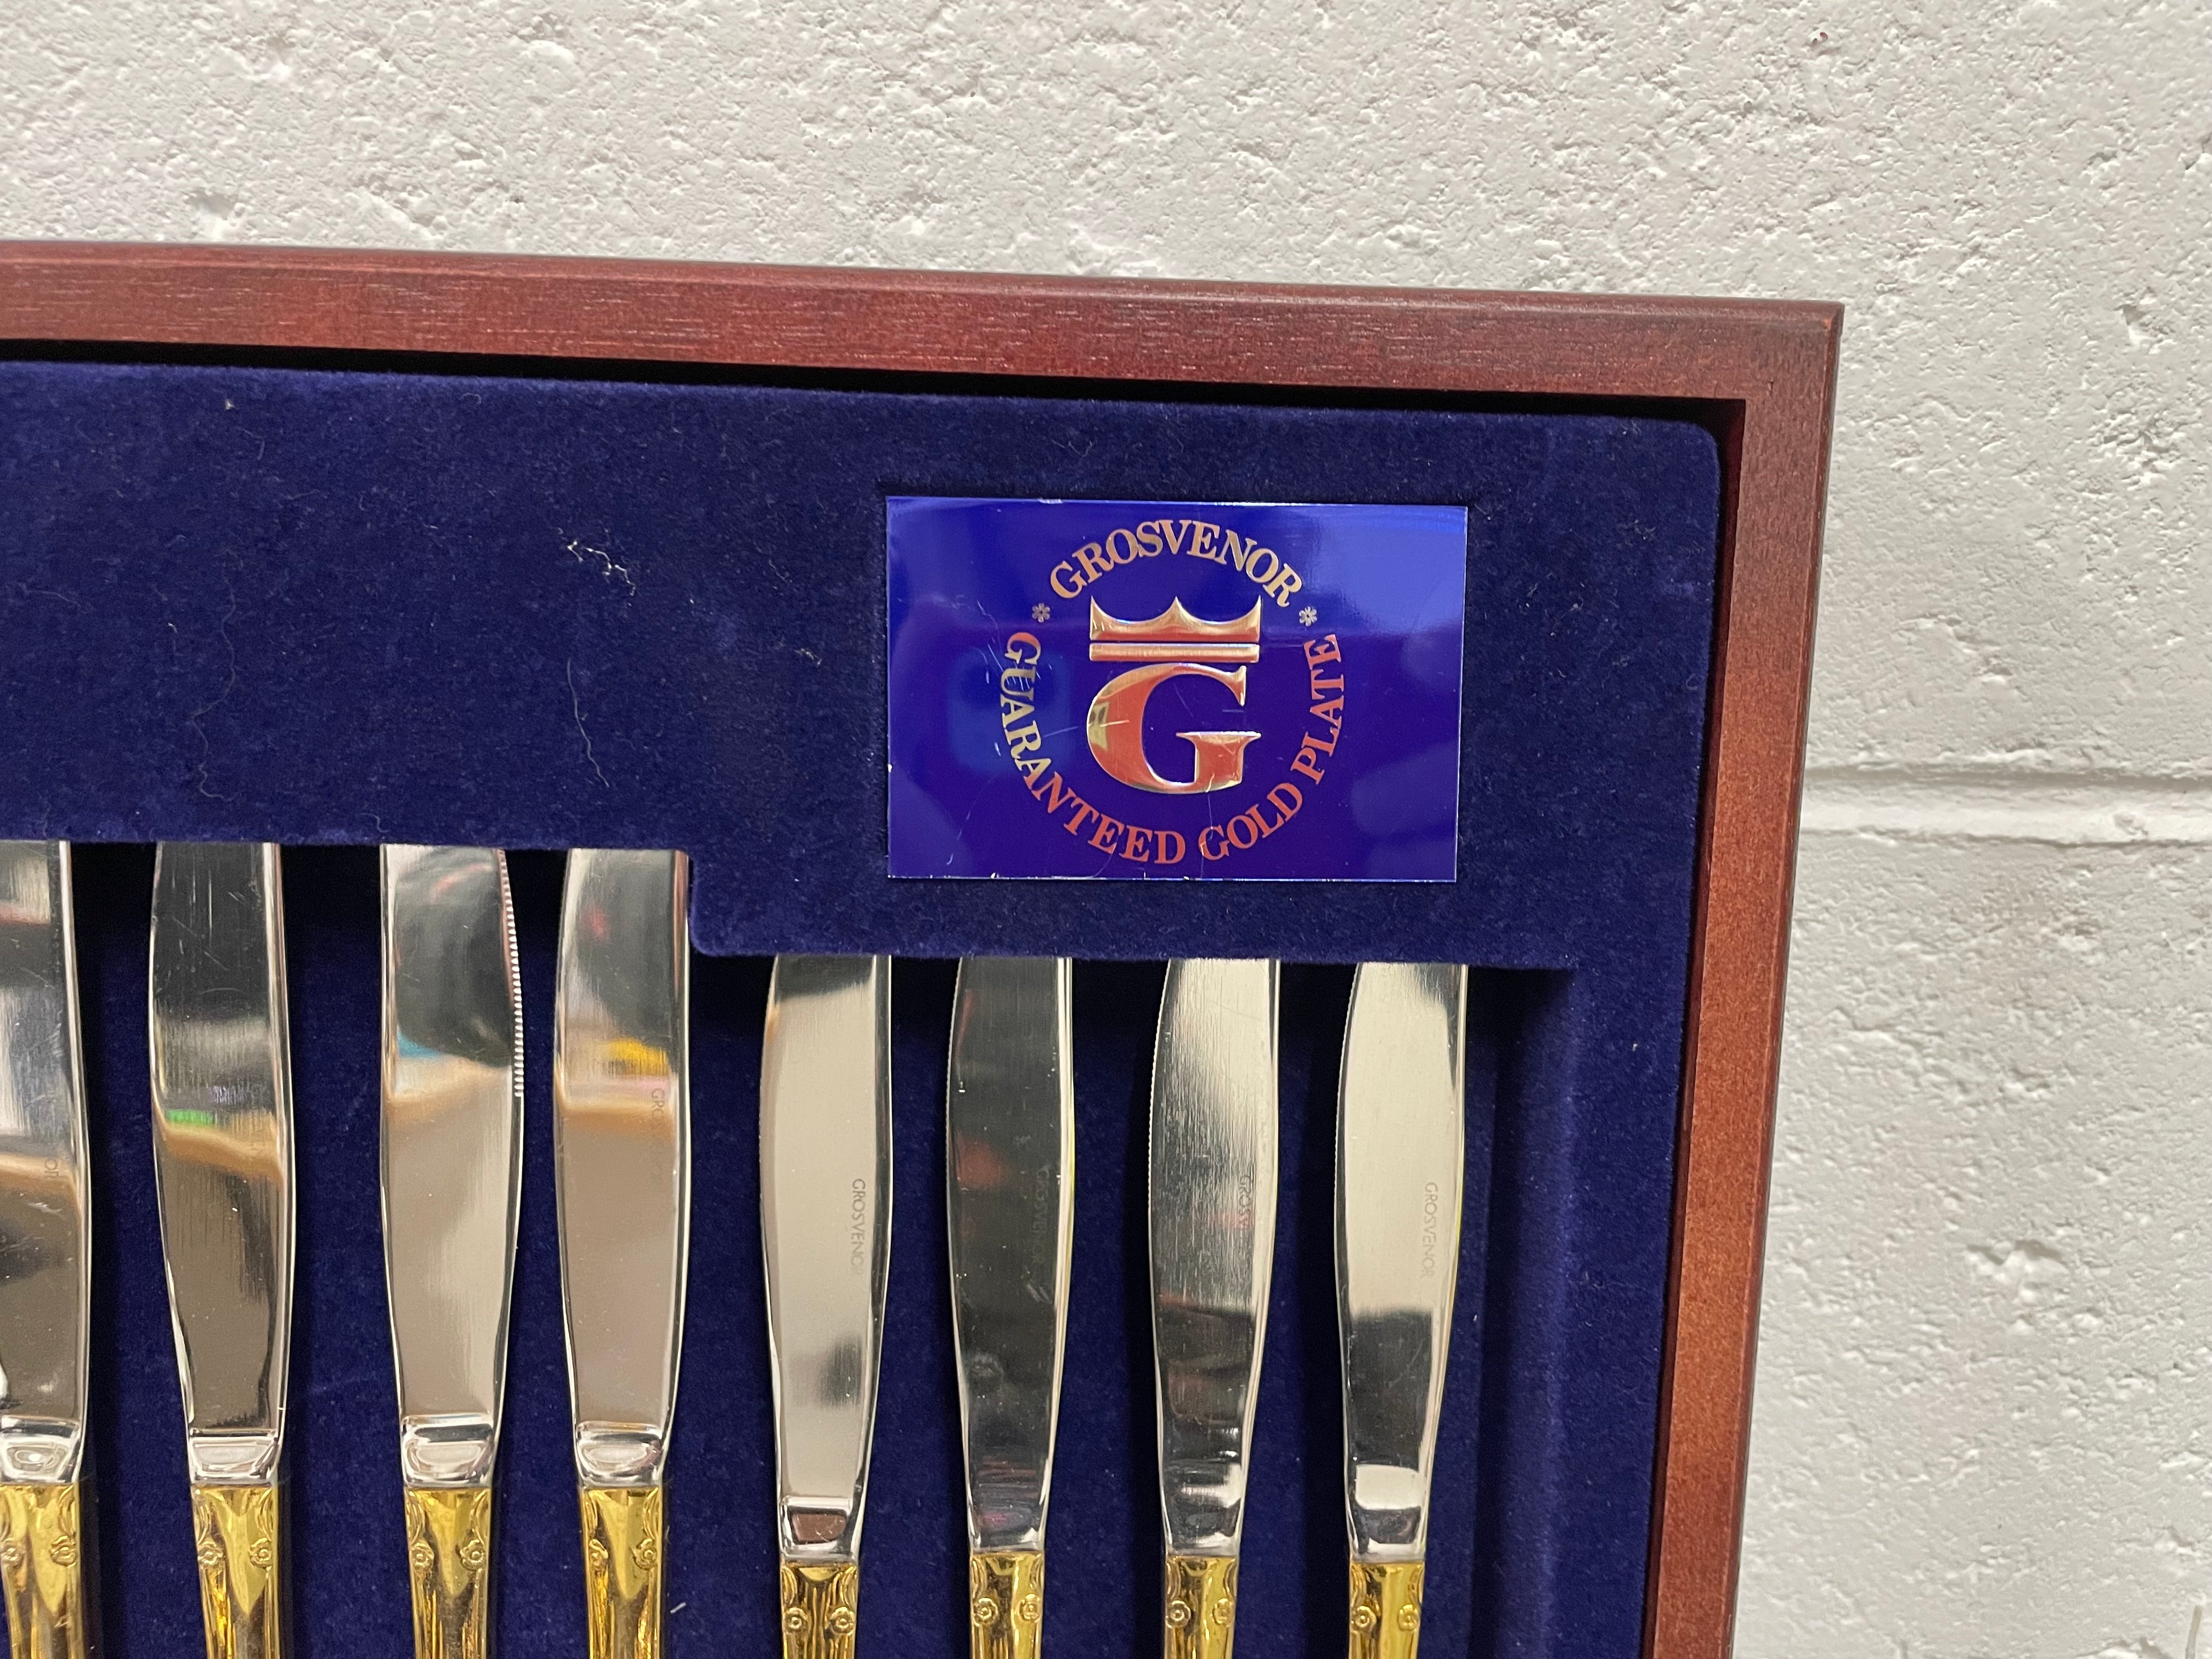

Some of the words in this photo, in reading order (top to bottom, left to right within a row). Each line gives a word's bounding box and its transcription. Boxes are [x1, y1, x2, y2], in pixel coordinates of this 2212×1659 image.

[1049, 519, 1303, 608] GROSVENOR
[1000, 631, 1186, 865] GUARANTEED
[1198, 781, 1305, 862] GOLD
[1291, 633, 1344, 785] PLATE
[1086, 662, 1261, 795] G
[1420, 1182, 1439, 1279] GROSVENOR
